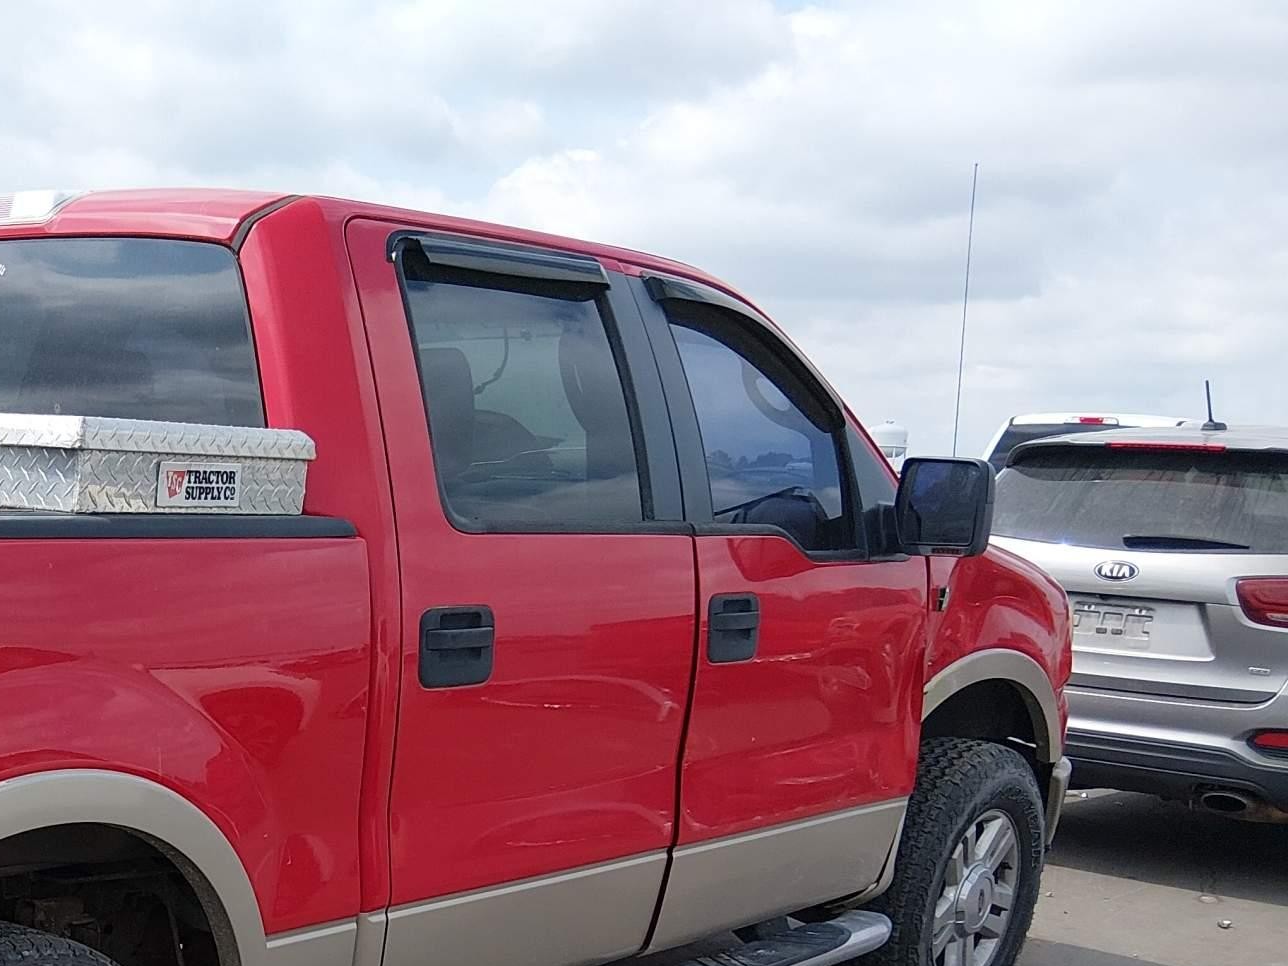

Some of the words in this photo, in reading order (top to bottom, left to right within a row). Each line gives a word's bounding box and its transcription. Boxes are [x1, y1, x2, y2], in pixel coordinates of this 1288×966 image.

[186, 470, 236, 485] TRACTOR
[184, 486, 223, 501] SUPPLY
[1100, 563, 1130, 578] KIA
